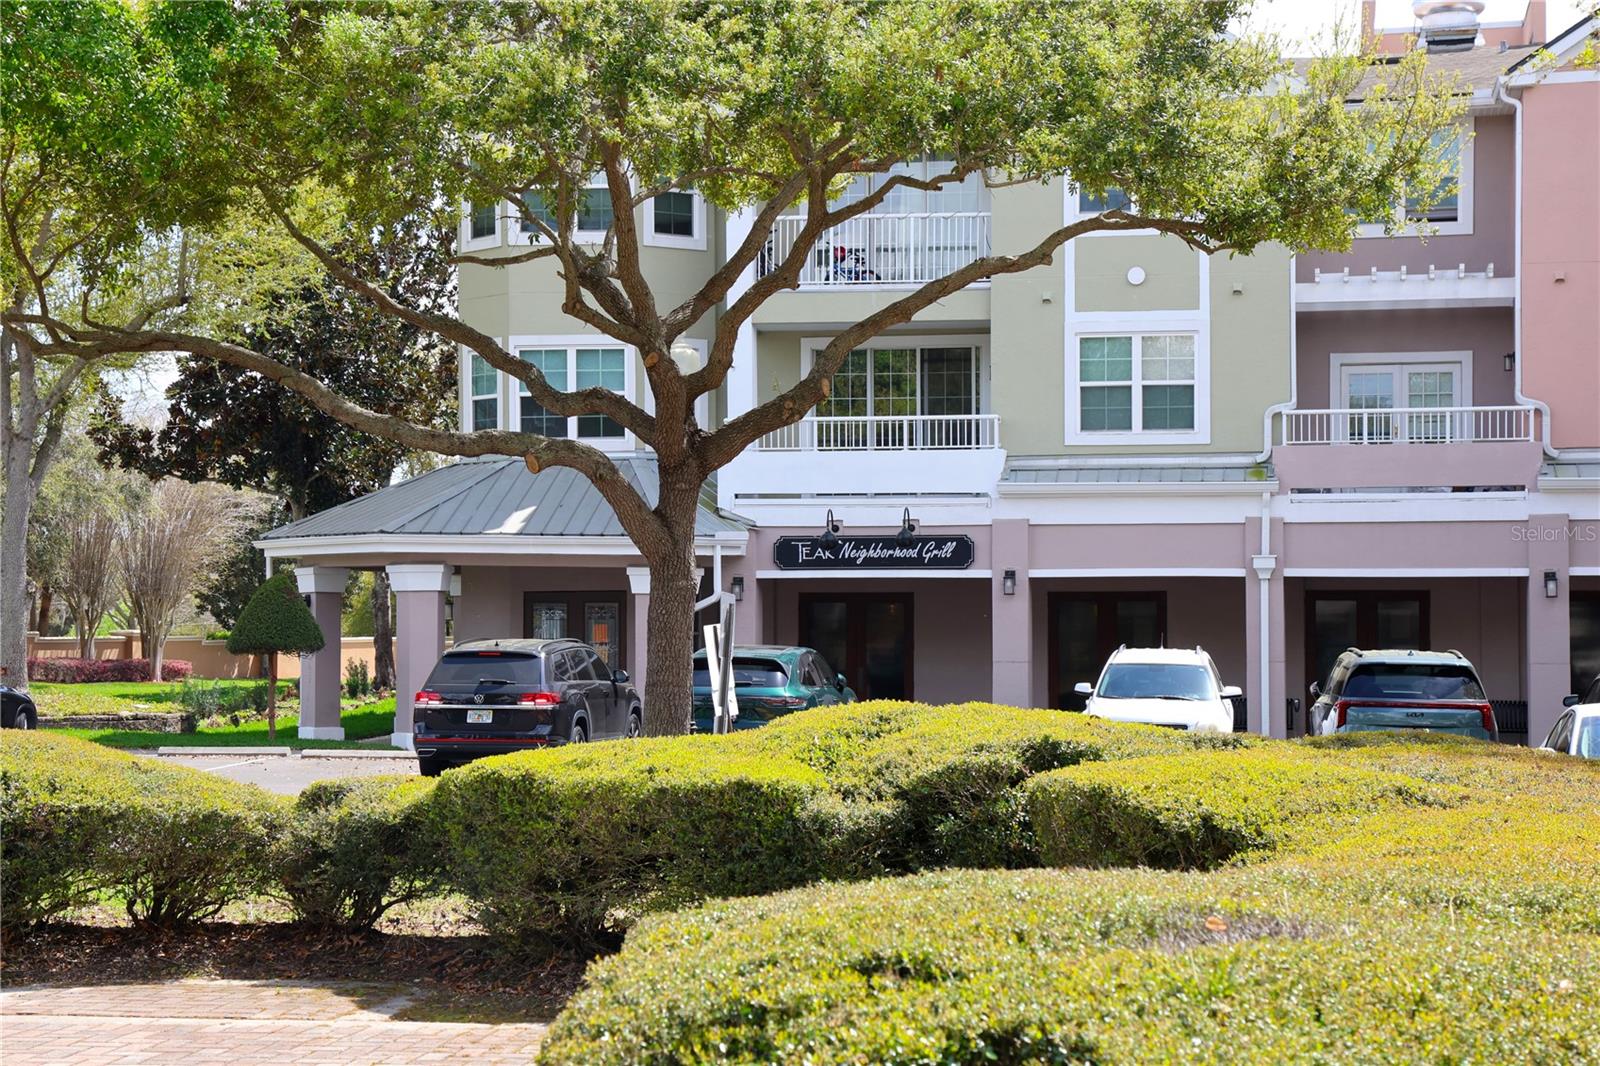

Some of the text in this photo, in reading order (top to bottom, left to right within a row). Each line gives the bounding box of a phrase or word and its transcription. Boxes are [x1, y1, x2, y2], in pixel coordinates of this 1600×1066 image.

[791, 540, 957, 564] TEAK Neighborhood Grill
